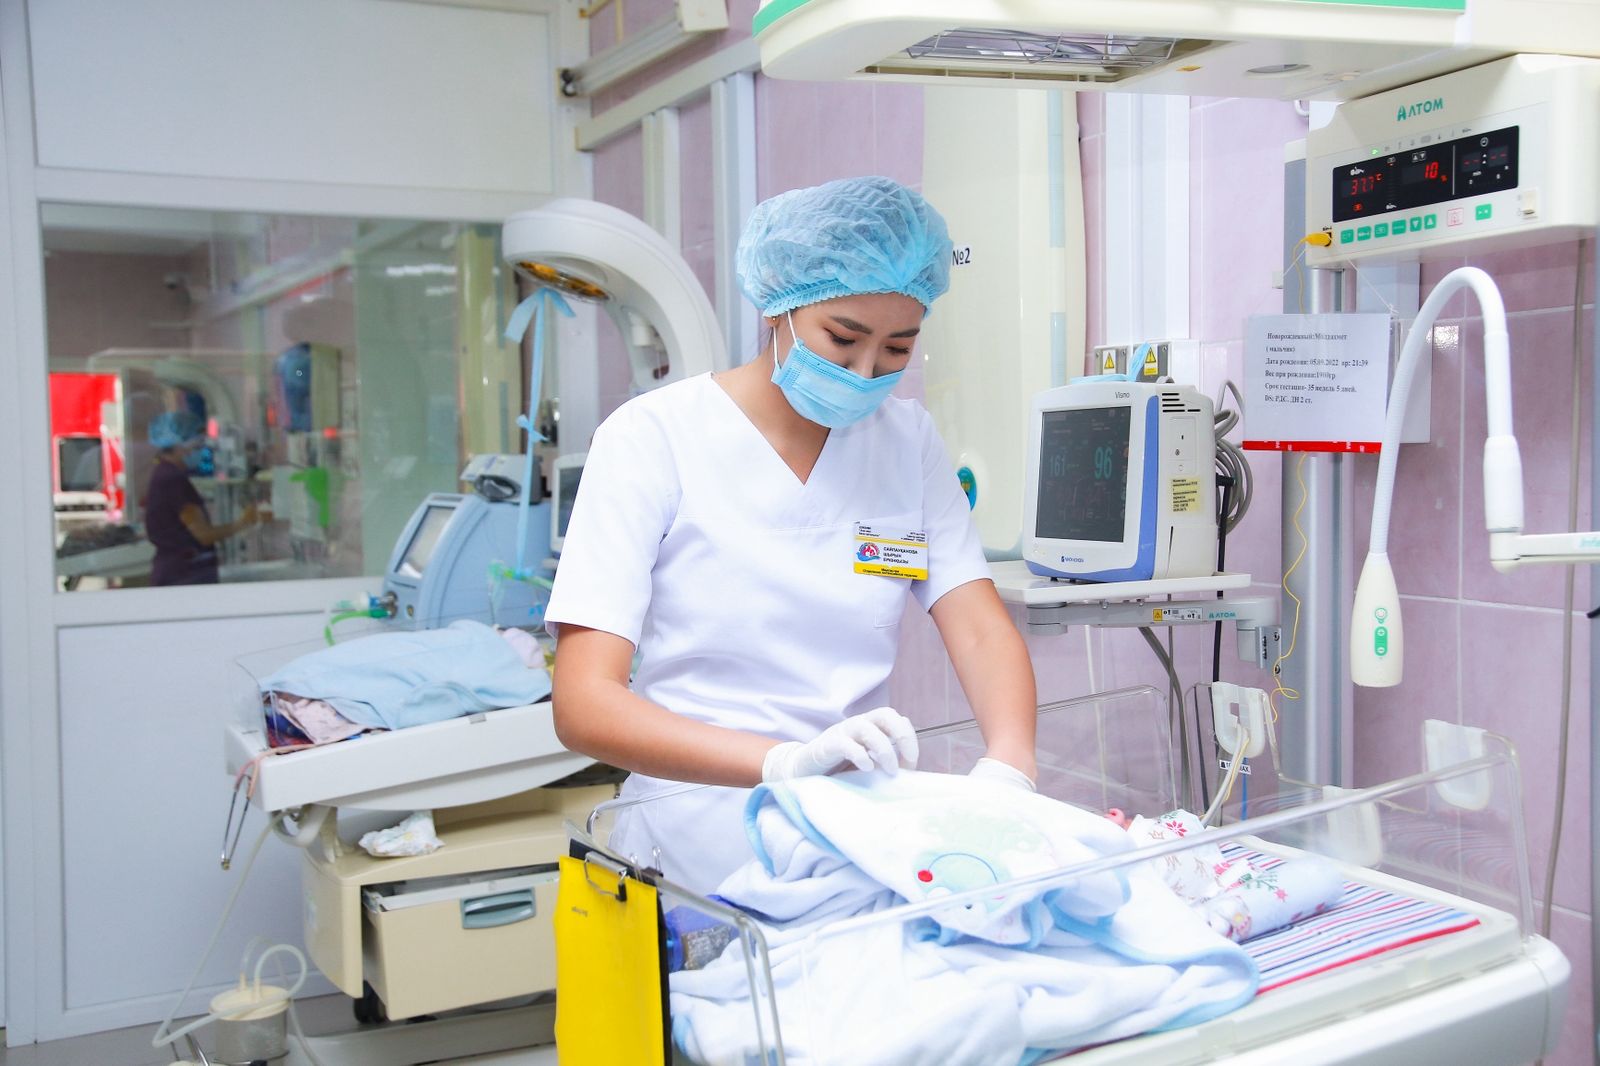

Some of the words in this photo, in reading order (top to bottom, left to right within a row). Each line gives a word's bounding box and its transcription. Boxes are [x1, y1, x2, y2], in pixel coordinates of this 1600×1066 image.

[1408, 97, 1443, 117] ATOM
[1424, 161, 1439, 180] 10
[1094, 446, 1113, 480] 96
